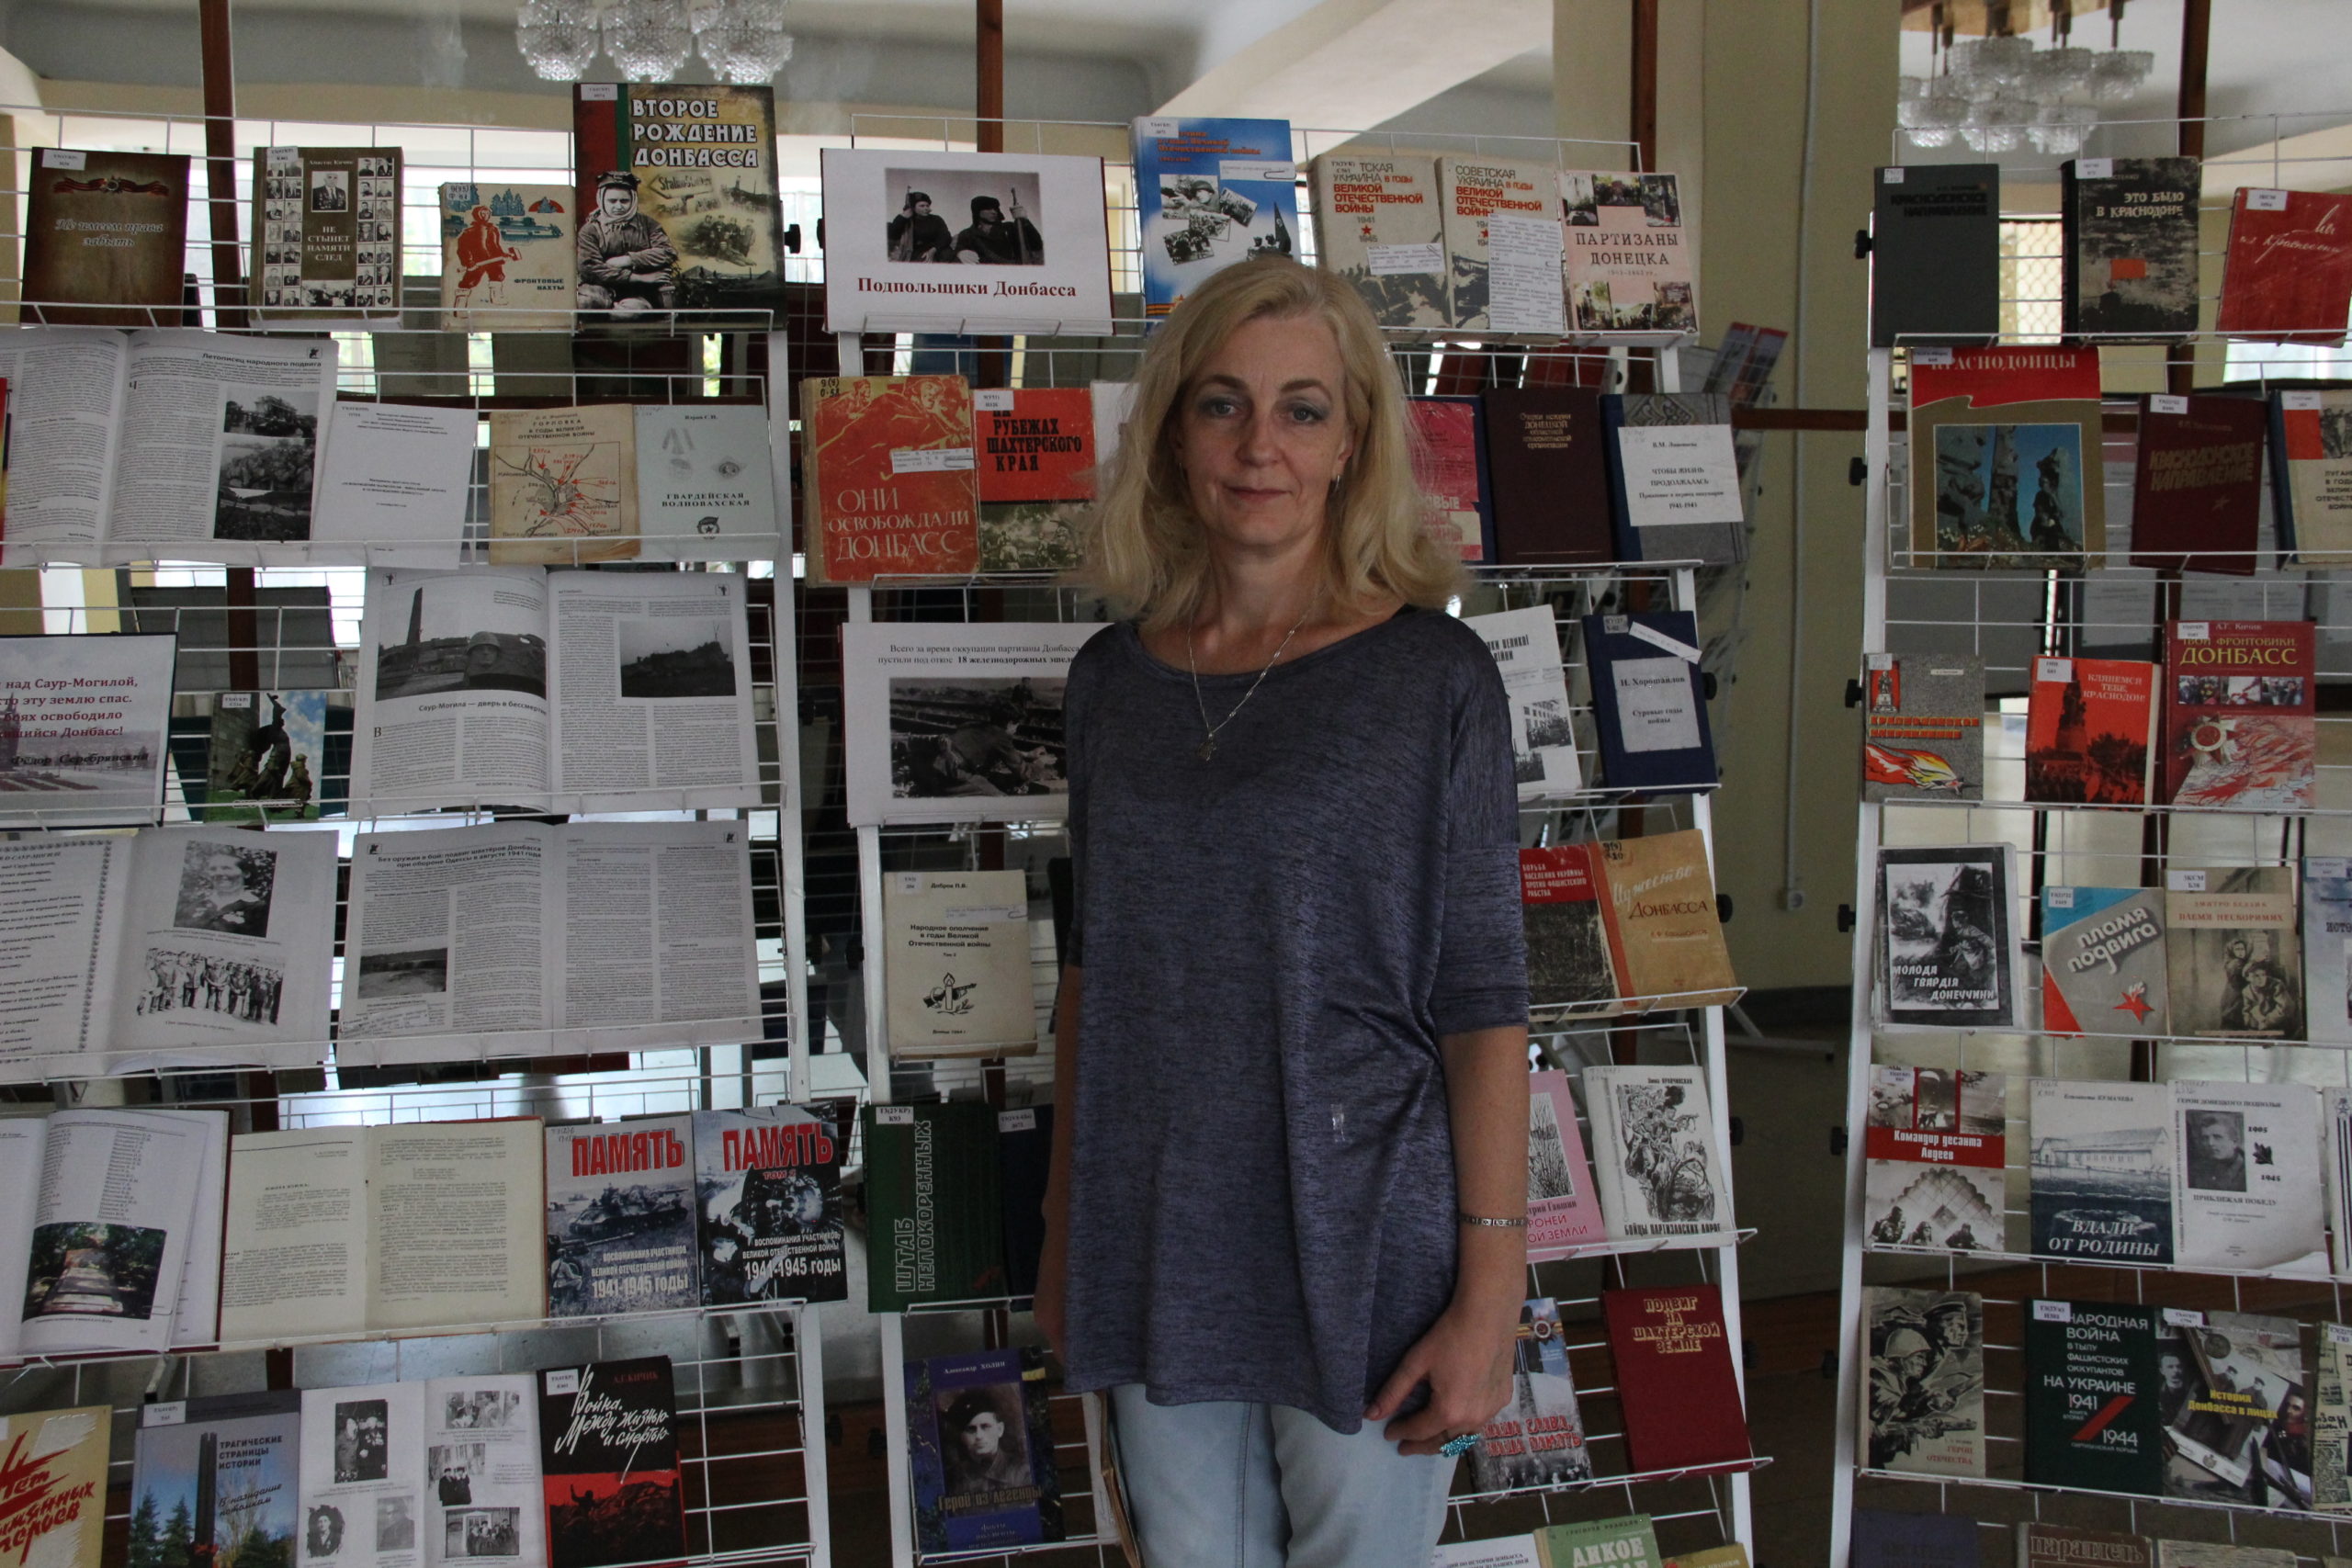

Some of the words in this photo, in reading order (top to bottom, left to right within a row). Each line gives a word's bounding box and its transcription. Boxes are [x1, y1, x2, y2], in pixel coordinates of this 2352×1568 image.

[633, 99, 719, 118] ВТОРОЕ
[633, 124, 758, 143] РОЖДЕНИЕ
[632, 148, 758, 167] ДОНБАССА
[1455, 165, 1515, 178] СОВЕТСКАЯ
[1334, 184, 1383, 194] ВЕЛИКОЙ
[1455, 186, 1503, 199] ВЕЛИКОЙ
[1334, 193, 1423, 204] ОТЕЧЕСТВЕННОЙ
[1455, 196, 1543, 211] ОТЕЧЕСТВЕННОЙ
[2123, 192, 2148, 203] ЭТО
[2153, 192, 2185, 203] БЫЛО
[1335, 203, 1374, 213] ВОЙНЫ
[2096, 207, 2105, 217] В
[2109, 205, 2184, 218] КРАСНОДОНЕ
[322, 226, 337, 234] НЕ
[308, 234, 350, 243] СТЫНЕТ
[1576, 233, 1678, 245] ПАРТИЗАНЫ
[307, 244, 351, 253] ПАМЯТИ
[314, 253, 343, 262] СЛЕД
[1591, 253, 1669, 266] ДОНЕЦКА
[858, 276, 988, 296] Подпольщики
[993, 279, 1076, 297] Донбасса
[994, 419, 1059, 435] РУБЕЖАХ
[987, 436, 1082, 454] ШАХТЕРСКОГО
[996, 456, 1040, 471] КРАЯ
[837, 487, 899, 513] ОНИ
[829, 511, 970, 534] ОСВОБОЖДАЛИ
[836, 531, 960, 562] ДОНБАСС
[890, 645, 914, 653] Всего
[926, 646, 950, 654] время
[953, 645, 996, 653] оккупации
[998, 645, 1041, 653] партизаны
[1042, 644, 1080, 653] Донбасса
[2180, 648, 2297, 665] ДОНБАСС
[969, 656, 1047, 665] железнодорожных
[6, 680, 31, 689] над
[35, 676, 138, 690] Саур-Могилой,
[23, 696, 47, 705] эту
[50, 695, 96, 705] землю
[98, 694, 132, 705] спас.
[40, 710, 122, 721] освободило
[61, 727, 123, 739] Донбасс!
[1526, 880, 1546, 888] ПРОТИВ
[1528, 889, 1552, 897] РАБСТВА
[1629, 901, 1708, 919] ДОНБАССА
[2077, 907, 2148, 949] пламя
[2067, 921, 2158, 974] подвига
[1893, 965, 1938, 976] МОЛОДА
[1914, 977, 1959, 987] ГВАРДІЯ
[1930, 990, 1995, 1000] ДОНЕЧЧИНИ
[1894, 1130, 1939, 1146] Командир
[1942, 1134, 1983, 1147] десанта
[572, 1129, 684, 1177] ПАМЯТЬ
[722, 1122, 833, 1172] ПАМЯТЬ
[1921, 1147, 1954, 1160] Авдеев
[914, 1120, 934, 1292] НЕПОКОРЕННЫХ
[1548, 1225, 1588, 1241] ЗЕМЛИ
[1624, 1224, 1648, 1235] БОЙЦЫ
[2072, 1220, 2133, 1235] ВДАЛИ
[754, 1235, 801, 1247] ВОСПОМИНАНИЯ
[802, 1232, 841, 1243] УЧАСТНИКОВ
[2048, 1237, 2069, 1252] ОТ
[2077, 1238, 2159, 1257] РОДИНЫ
[743, 1249, 770, 1260] ВЕЛИКОЙ
[772, 1245, 816, 1258] ОТЕЧЕСТВЕННОЙ
[817, 1243, 839, 1253] ВОЙНЫ
[895, 1217, 915, 1292] ШТАБ
[592, 1266, 618, 1277] ВЕЛИКОЙ
[745, 1258, 808, 1280] 1941-1945
[594, 1277, 652, 1298] 1941-1945
[1644, 1297, 1698, 1313] ПОДВИГ
[1665, 1312, 1683, 1325] НА
[2069, 1314, 2149, 1330] НАРОДНАЯ
[1632, 1323, 1720, 1342] ШАХТЕРСКОЙ
[2066, 1327, 2120, 1343] ВОЙНА
[1657, 1338, 1702, 1353] ЗЕМЛЕ
[2075, 1343, 2097, 1352] ТЫЛУ
[2067, 1354, 2129, 1365] ФАШИСТСКИХ
[2066, 1365, 2125, 1376] ОККУПАНТОВ
[572, 1363, 623, 1416] Война.
[2043, 1375, 2064, 1388] НА
[2067, 1377, 2136, 1394] УКРАИНЕ
[2068, 1393, 2098, 1411] 1941
[2210, 1389, 2252, 1404] История
[2188, 1400, 2238, 1415] Донбасса
[2246, 1407, 2278, 1419] лицах
[555, 1413, 617, 1455] Между
[622, 1410, 669, 1433] жизнью
[1526, 1416, 1573, 1434] СЛАВА,
[220, 1435, 283, 1450] ТРАГИЧЕСКИЕ
[1487, 1438, 1526, 1457] НАША
[1529, 1434, 1581, 1451] ПАМЯТЬ
[2102, 1429, 2139, 1448] 1944
[219, 1448, 269, 1460] СТРАНИЦЫ
[219, 1459, 261, 1470] ИСТОРИИ
[231, 1483, 282, 1506] назидание
[220, 1496, 271, 1517] потомкам
[939, 1495, 972, 1512] Герой
[976, 1494, 989, 1506] из
